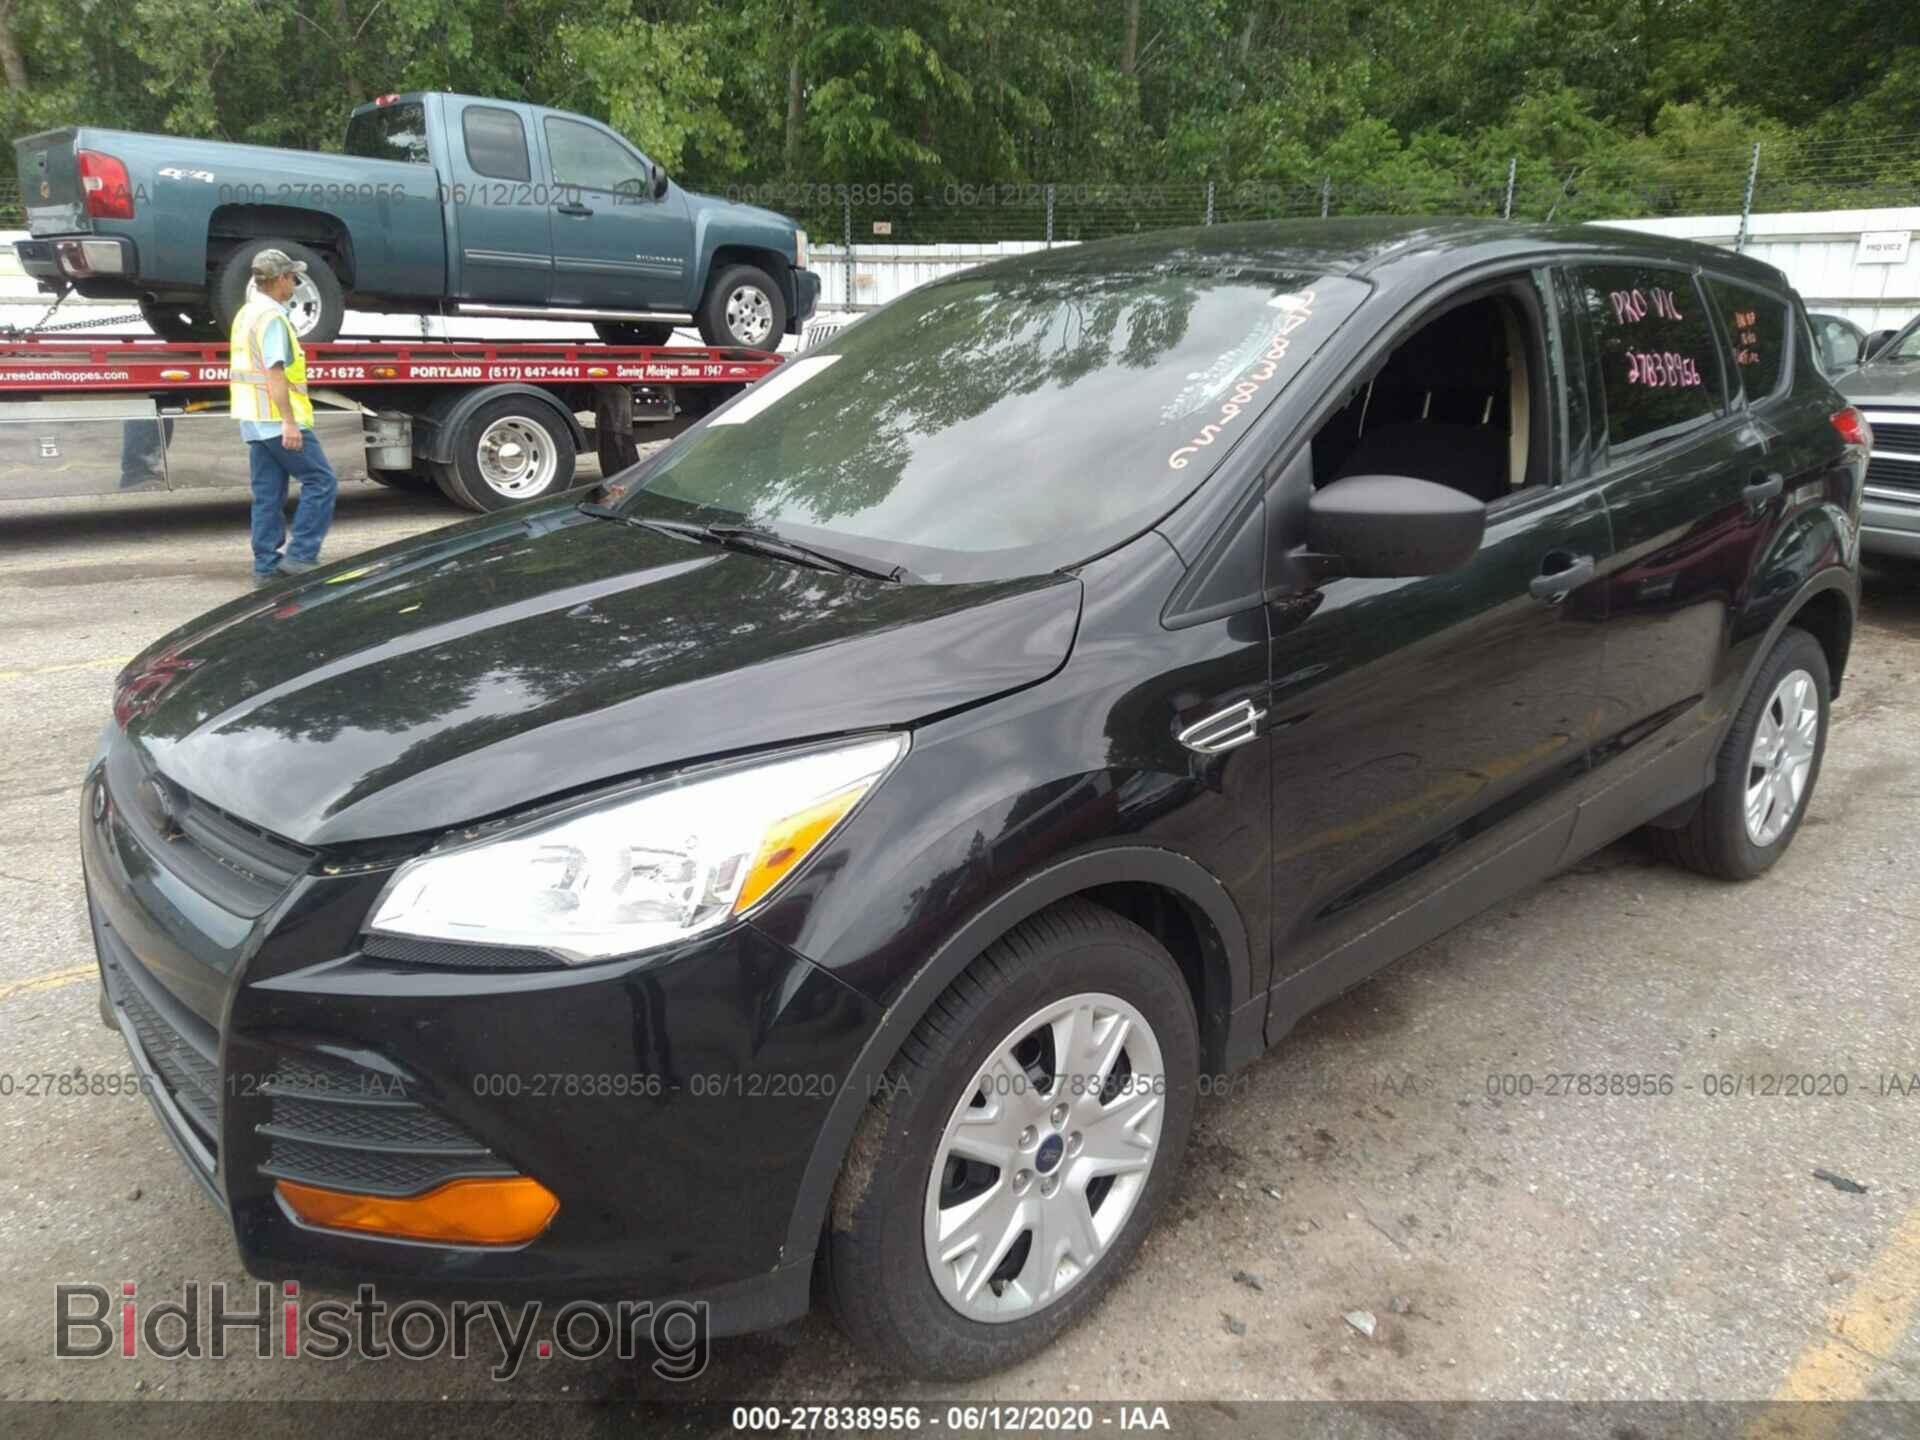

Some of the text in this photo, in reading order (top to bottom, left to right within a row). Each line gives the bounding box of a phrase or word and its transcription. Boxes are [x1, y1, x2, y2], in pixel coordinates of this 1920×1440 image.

[1610, 287, 1683, 325] PRO VIC
[410, 366, 580, 380] PORTLAND (517) 647-4441
[616, 364, 644, 380] Serving
[646, 364, 679, 380] Michigan
[703, 365, 724, 377] 1947
[1168, 290, 1315, 470] 27838956
[1626, 351, 1701, 387] 27838956
